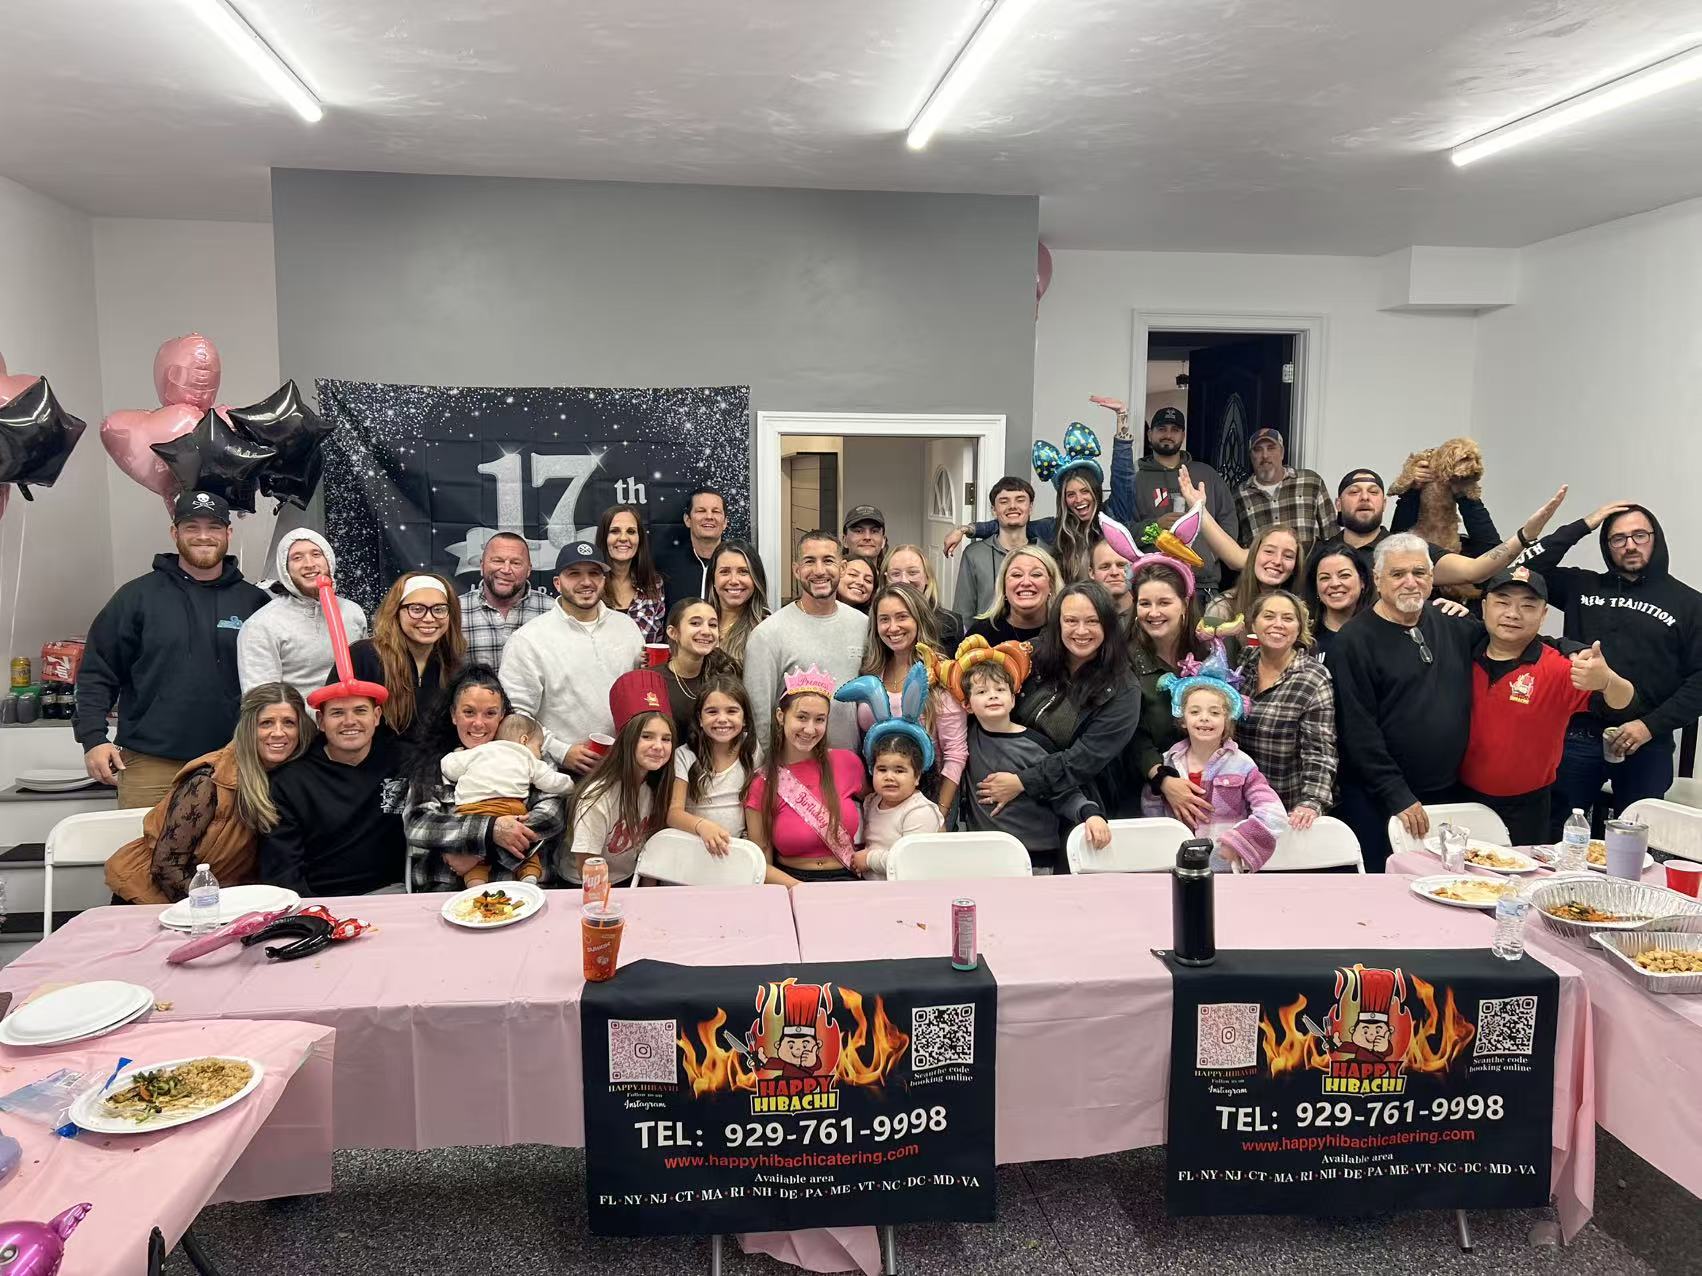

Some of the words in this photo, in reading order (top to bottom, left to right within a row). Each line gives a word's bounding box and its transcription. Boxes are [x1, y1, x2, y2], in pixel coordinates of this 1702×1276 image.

[477, 453, 599, 548] 17
[614, 476, 648, 505] th
[1580, 594, 1606, 607] NEW
[796, 792, 829, 829] Birthday
[949, 1065, 970, 1074] code
[1332, 1062, 1400, 1078] HAPPY
[1469, 1064, 1501, 1073] booking
[1503, 1063, 1532, 1072] online
[760, 1077, 831, 1096] HAPPY
[910, 1075, 944, 1087] booking
[945, 1073, 973, 1082] online
[1325, 1077, 1404, 1093] HIBACHI
[1208, 1085, 1248, 1097] Instagram
[624, 1099, 667, 1111] Instagram
[754, 1093, 836, 1112] HIBACHI
[1215, 1105, 1278, 1132] TEL:
[1296, 1094, 1505, 1128] 929-761-9998
[634, 1120, 703, 1149] TEL:
[724, 1105, 948, 1148] 929-761-9998
[1241, 1129, 1475, 1151] www.happyhibachicatering.com
[664, 1144, 920, 1169] www.happyhibachicatering.com
[1321, 1154, 1370, 1164] Available
[1371, 1153, 1394, 1162] area
[754, 1173, 807, 1185] Available
[809, 1175, 835, 1183] area
